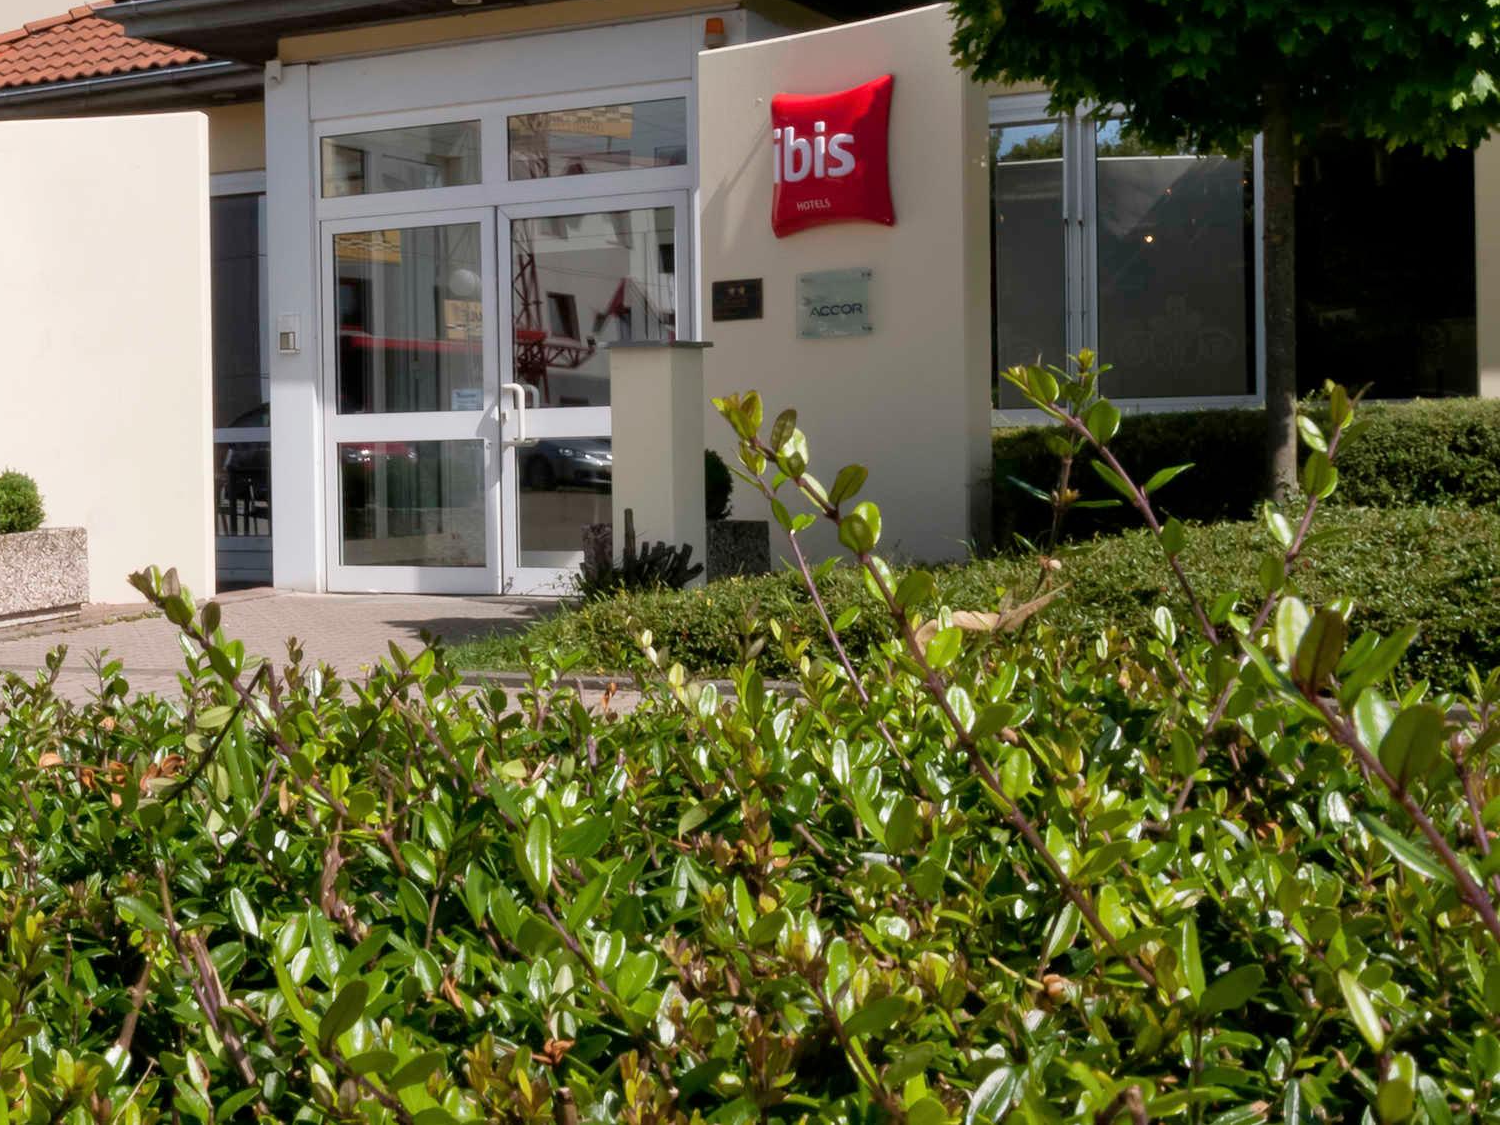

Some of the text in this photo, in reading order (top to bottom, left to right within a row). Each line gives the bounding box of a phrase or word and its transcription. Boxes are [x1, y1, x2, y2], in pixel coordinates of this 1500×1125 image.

[772, 121, 856, 183] ibis
[796, 198, 831, 211] HOTELS
[809, 303, 863, 317] ACCOR
